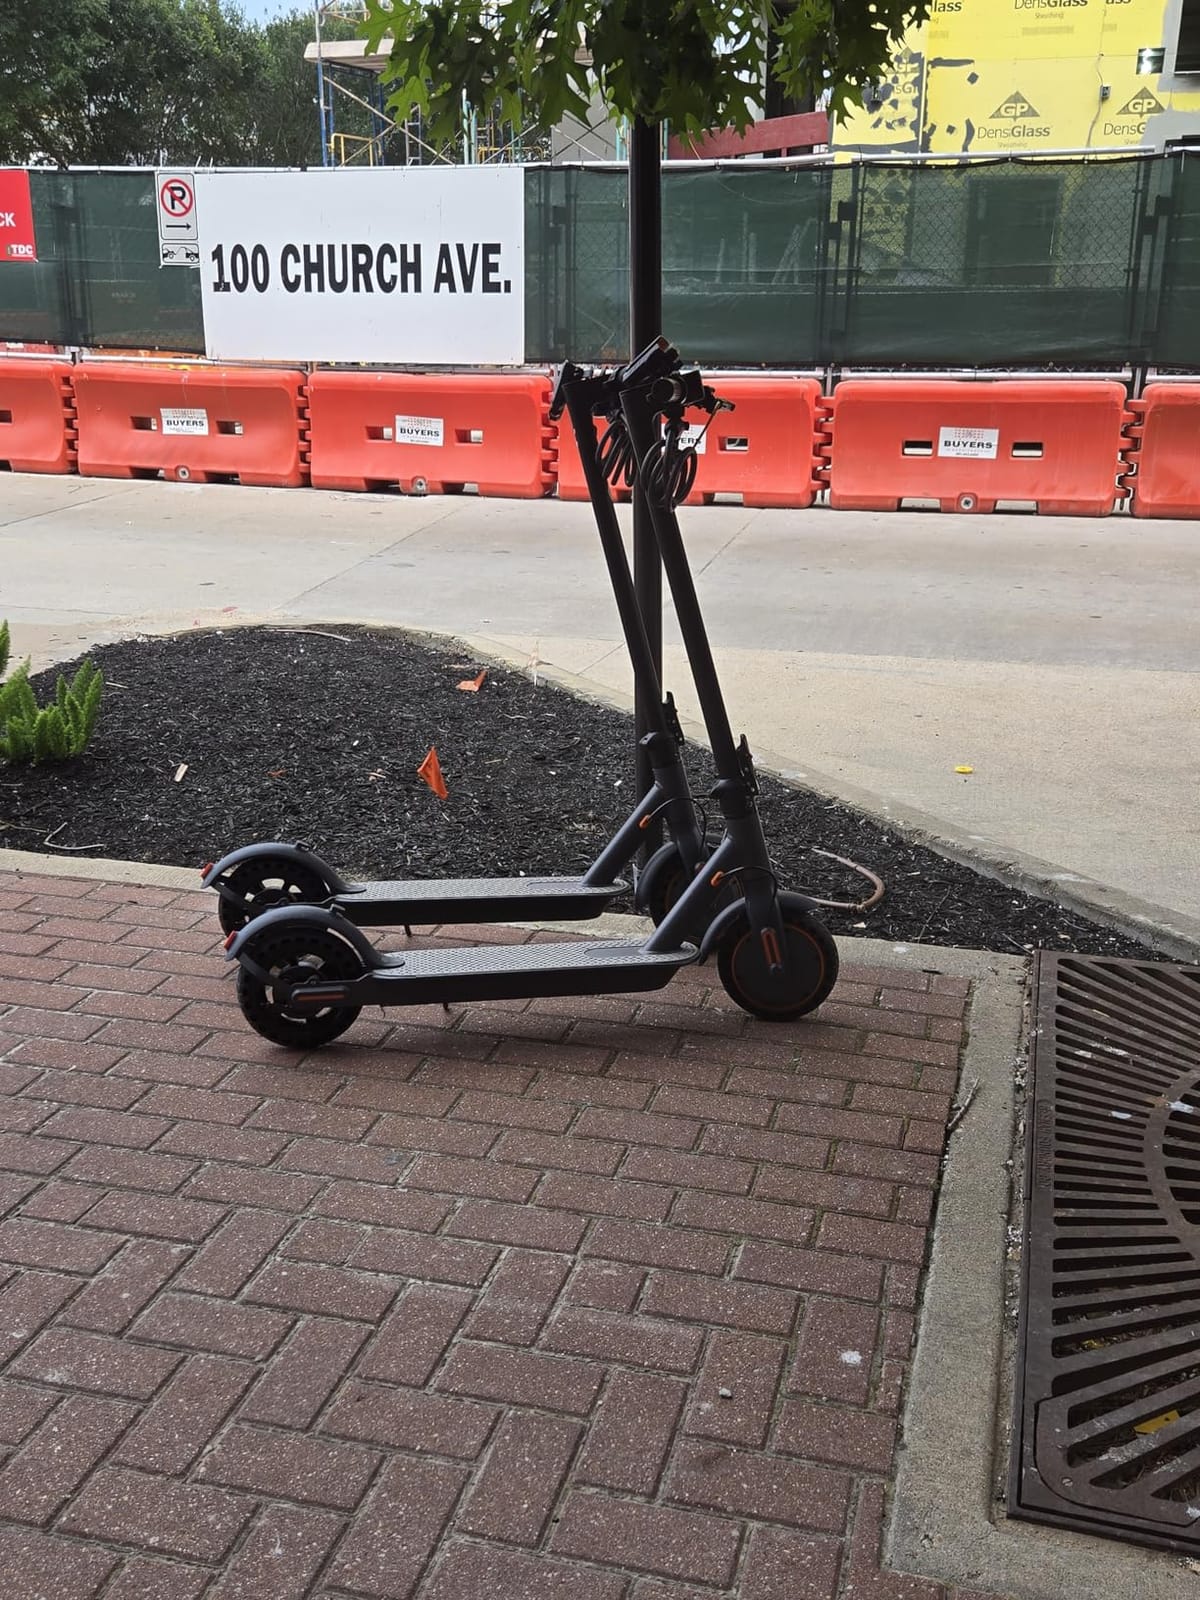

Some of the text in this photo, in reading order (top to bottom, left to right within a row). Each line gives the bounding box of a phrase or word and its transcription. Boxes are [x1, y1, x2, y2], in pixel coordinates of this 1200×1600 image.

[999, 102, 1029, 117] GP
[1127, 98, 1157, 113] GP
[977, 124, 1051, 140] DensGlass
[11, 243, 33, 255] TDC
[211, 242, 512, 293] 100 CHURCH AVE.
[166, 419, 204, 427] BUYERS
[400, 427, 440, 437] BUYERS
[944, 440, 993, 451] BUYERS
